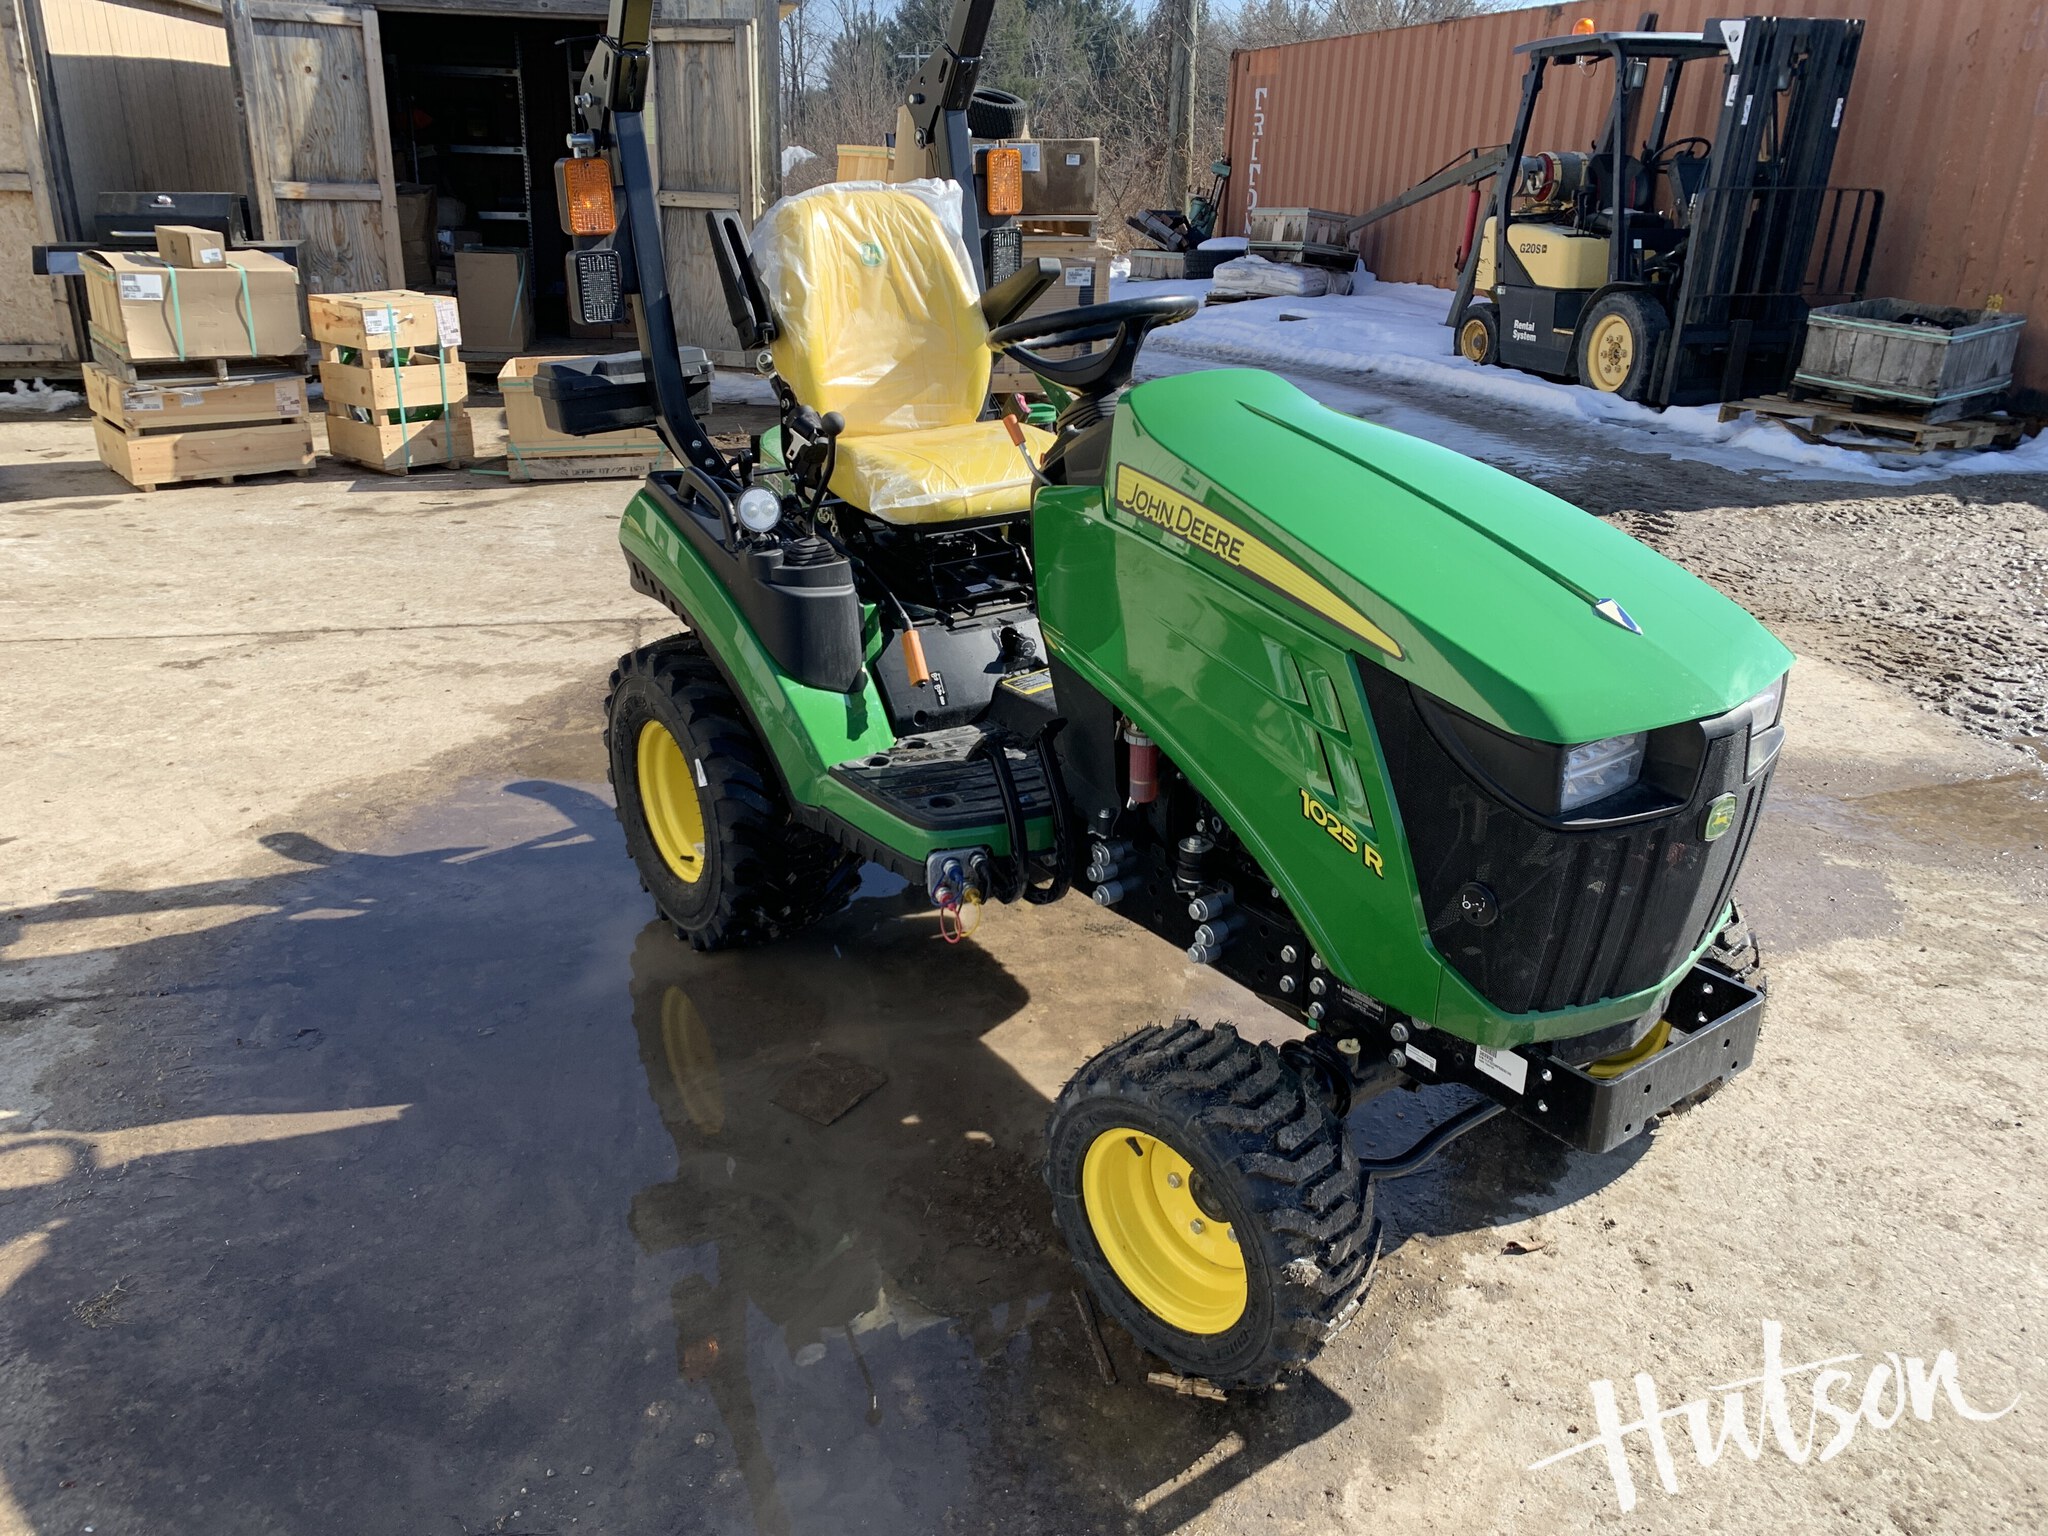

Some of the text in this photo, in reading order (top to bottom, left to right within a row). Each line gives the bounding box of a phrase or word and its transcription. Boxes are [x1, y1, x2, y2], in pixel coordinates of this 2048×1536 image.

[1512, 329, 1537, 342] System
[1513, 319, 1536, 332] Rental
[1124, 482, 1246, 564] JOHN DEERE
[1299, 787, 1384, 879] 1025 R
